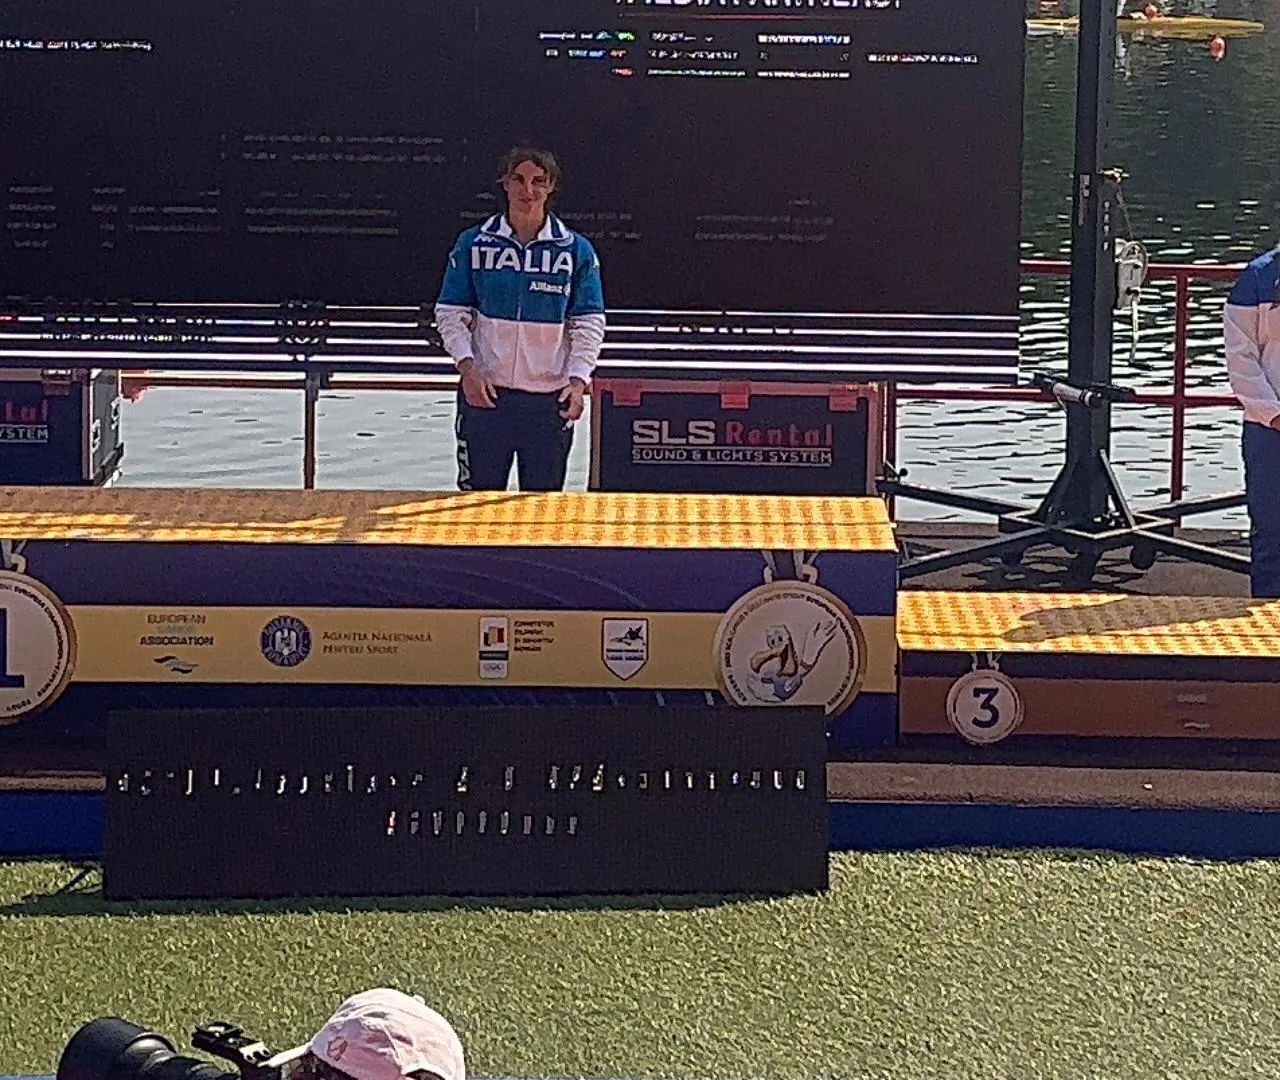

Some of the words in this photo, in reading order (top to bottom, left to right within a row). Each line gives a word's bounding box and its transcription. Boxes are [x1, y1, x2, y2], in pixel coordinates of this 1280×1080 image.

[471, 245, 574, 277] ITALIA
[632, 420, 716, 445] SLS
[725, 421, 833, 446] Rental
[632, 448, 687, 461] SOUND
[706, 449, 764, 462] LIGHTS
[769, 450, 833, 464] SYSTEM
[147, 613, 207, 624] EUROPEAN
[139, 635, 215, 646] ASSOCIATION
[971, 686, 1000, 729] 3
